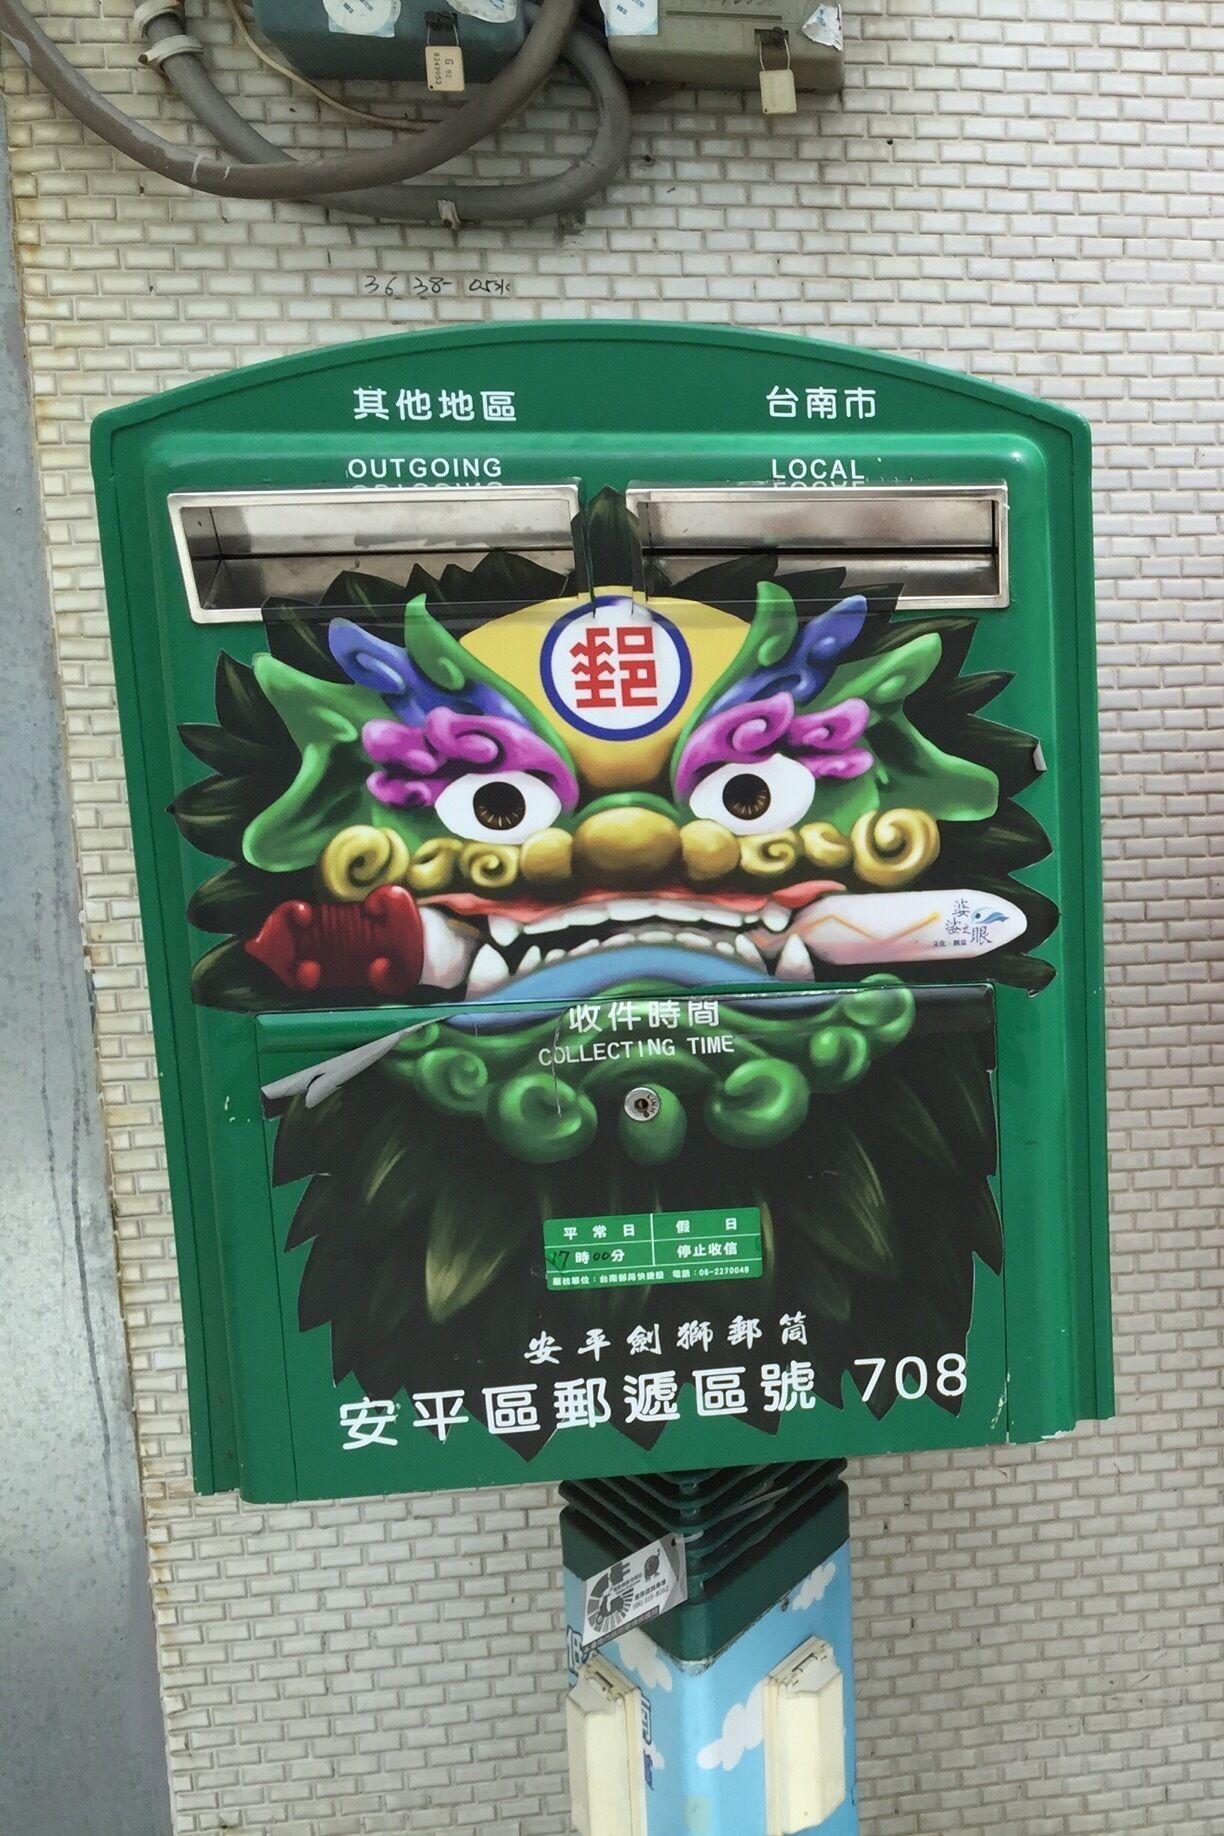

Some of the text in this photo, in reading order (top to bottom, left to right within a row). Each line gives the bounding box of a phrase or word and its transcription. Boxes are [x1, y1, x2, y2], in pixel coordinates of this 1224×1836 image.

[353, 386, 518, 422] 其他地區
[766, 387, 877, 420] 台南市
[347, 457, 502, 479] OUTGOING
[772, 458, 866, 481] LOCAL
[569, 999, 720, 1033] 收件時間
[538, 1035, 735, 1066] COLLECTING TIME
[677, 1241, 738, 1258] 停止收信
[524, 1310, 808, 1364] 安平劍獅郵筒
[338, 1352, 968, 1450] 安平區郵遞區號 708
